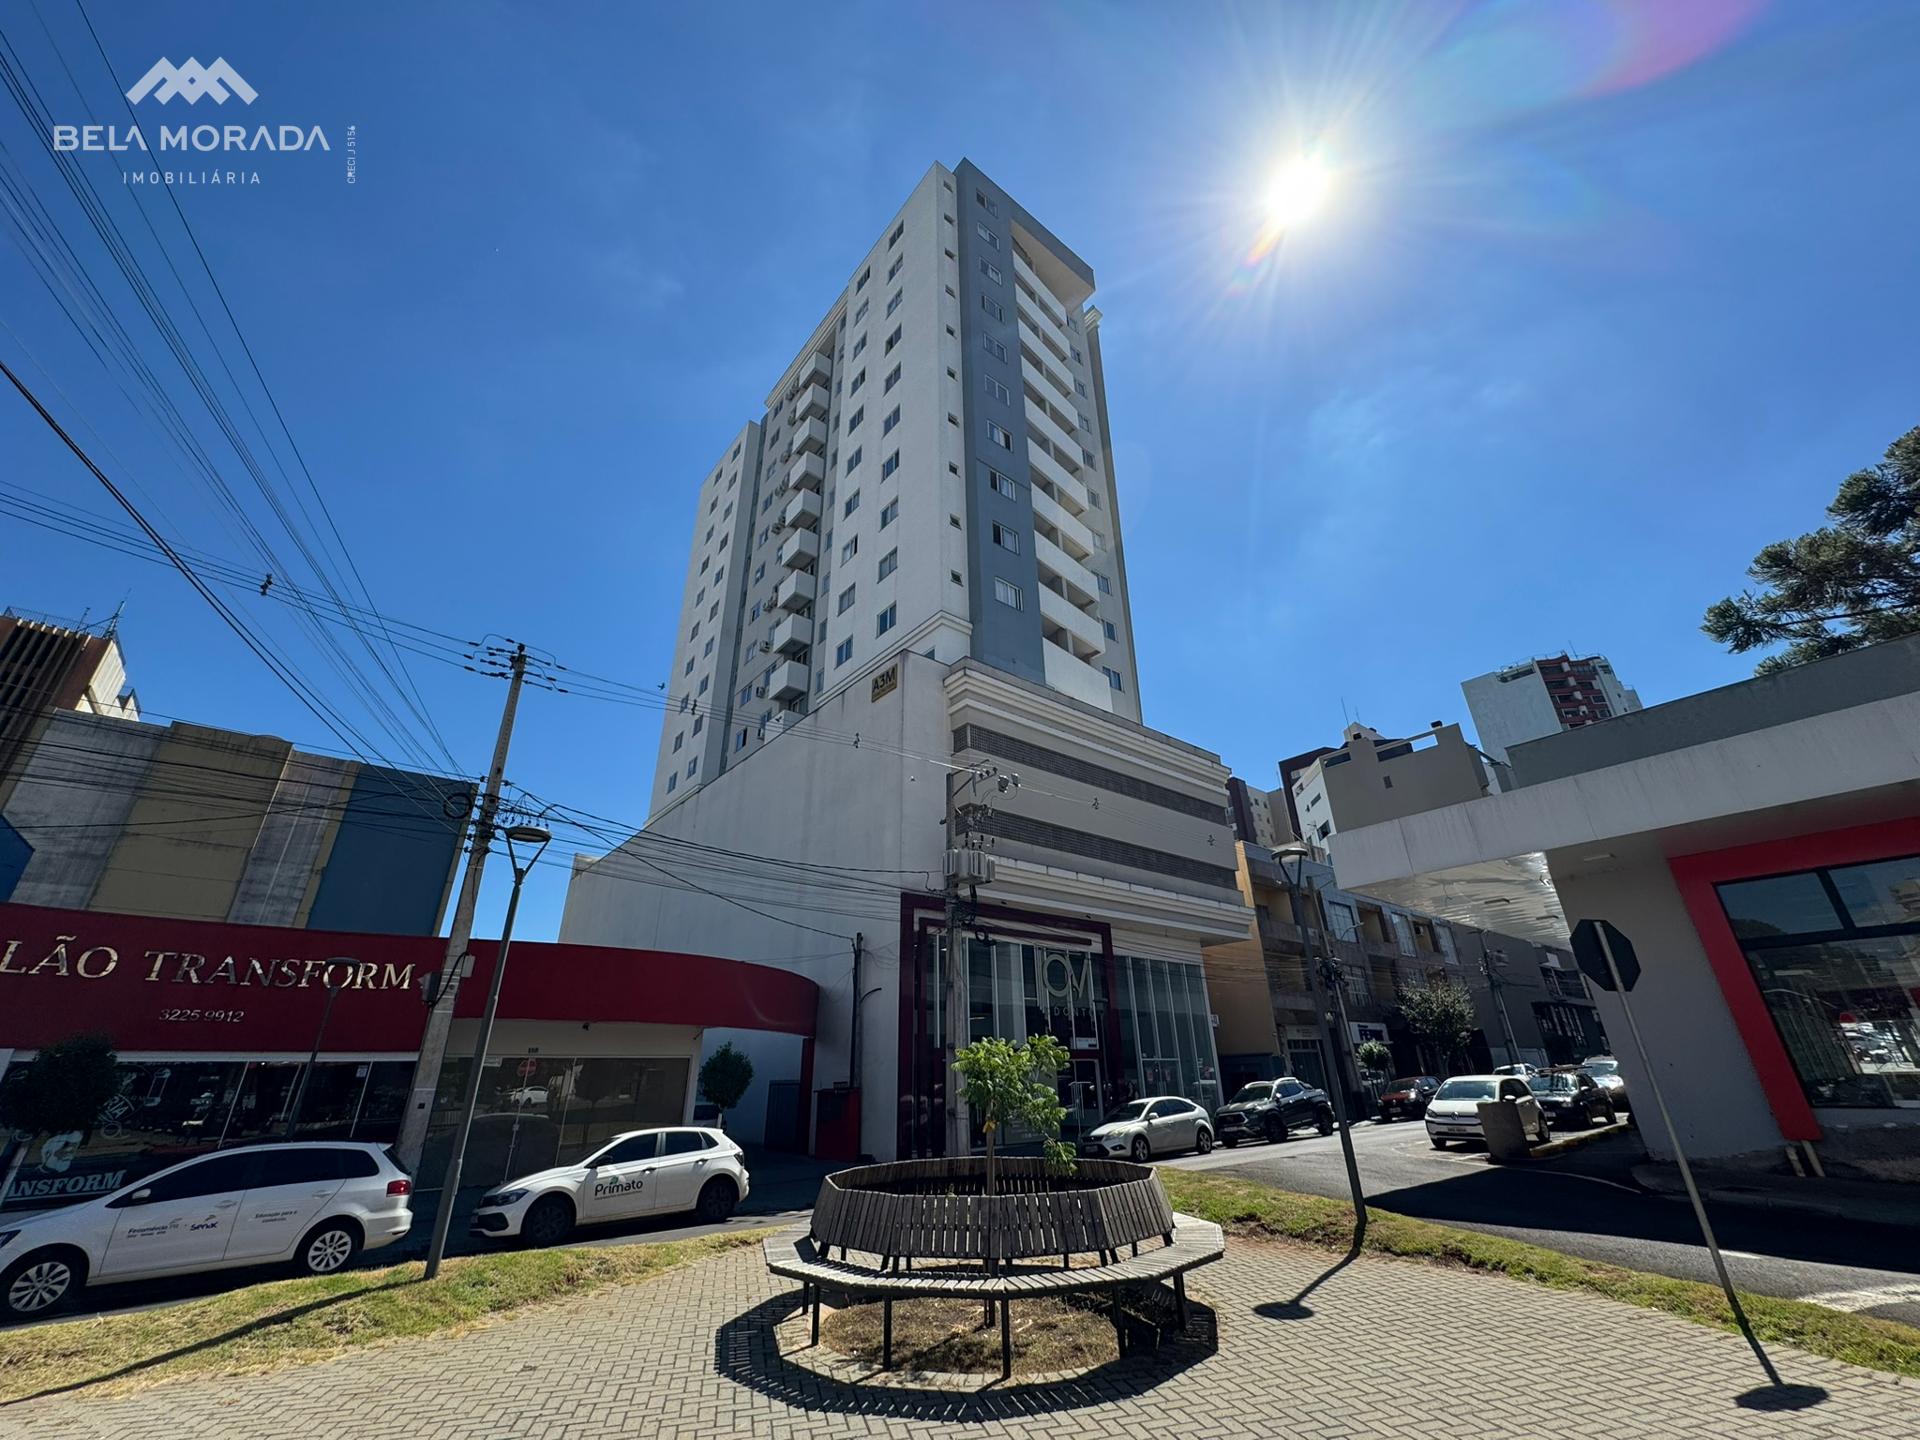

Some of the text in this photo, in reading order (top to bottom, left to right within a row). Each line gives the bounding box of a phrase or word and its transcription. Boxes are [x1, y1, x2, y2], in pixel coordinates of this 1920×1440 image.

[872, 666, 896, 690] A3M
[0, 935, 416, 989] LÃO TRANSFORM
[158, 1008, 245, 1023] 3225 9912
[594, 1179, 644, 1197] Primato
